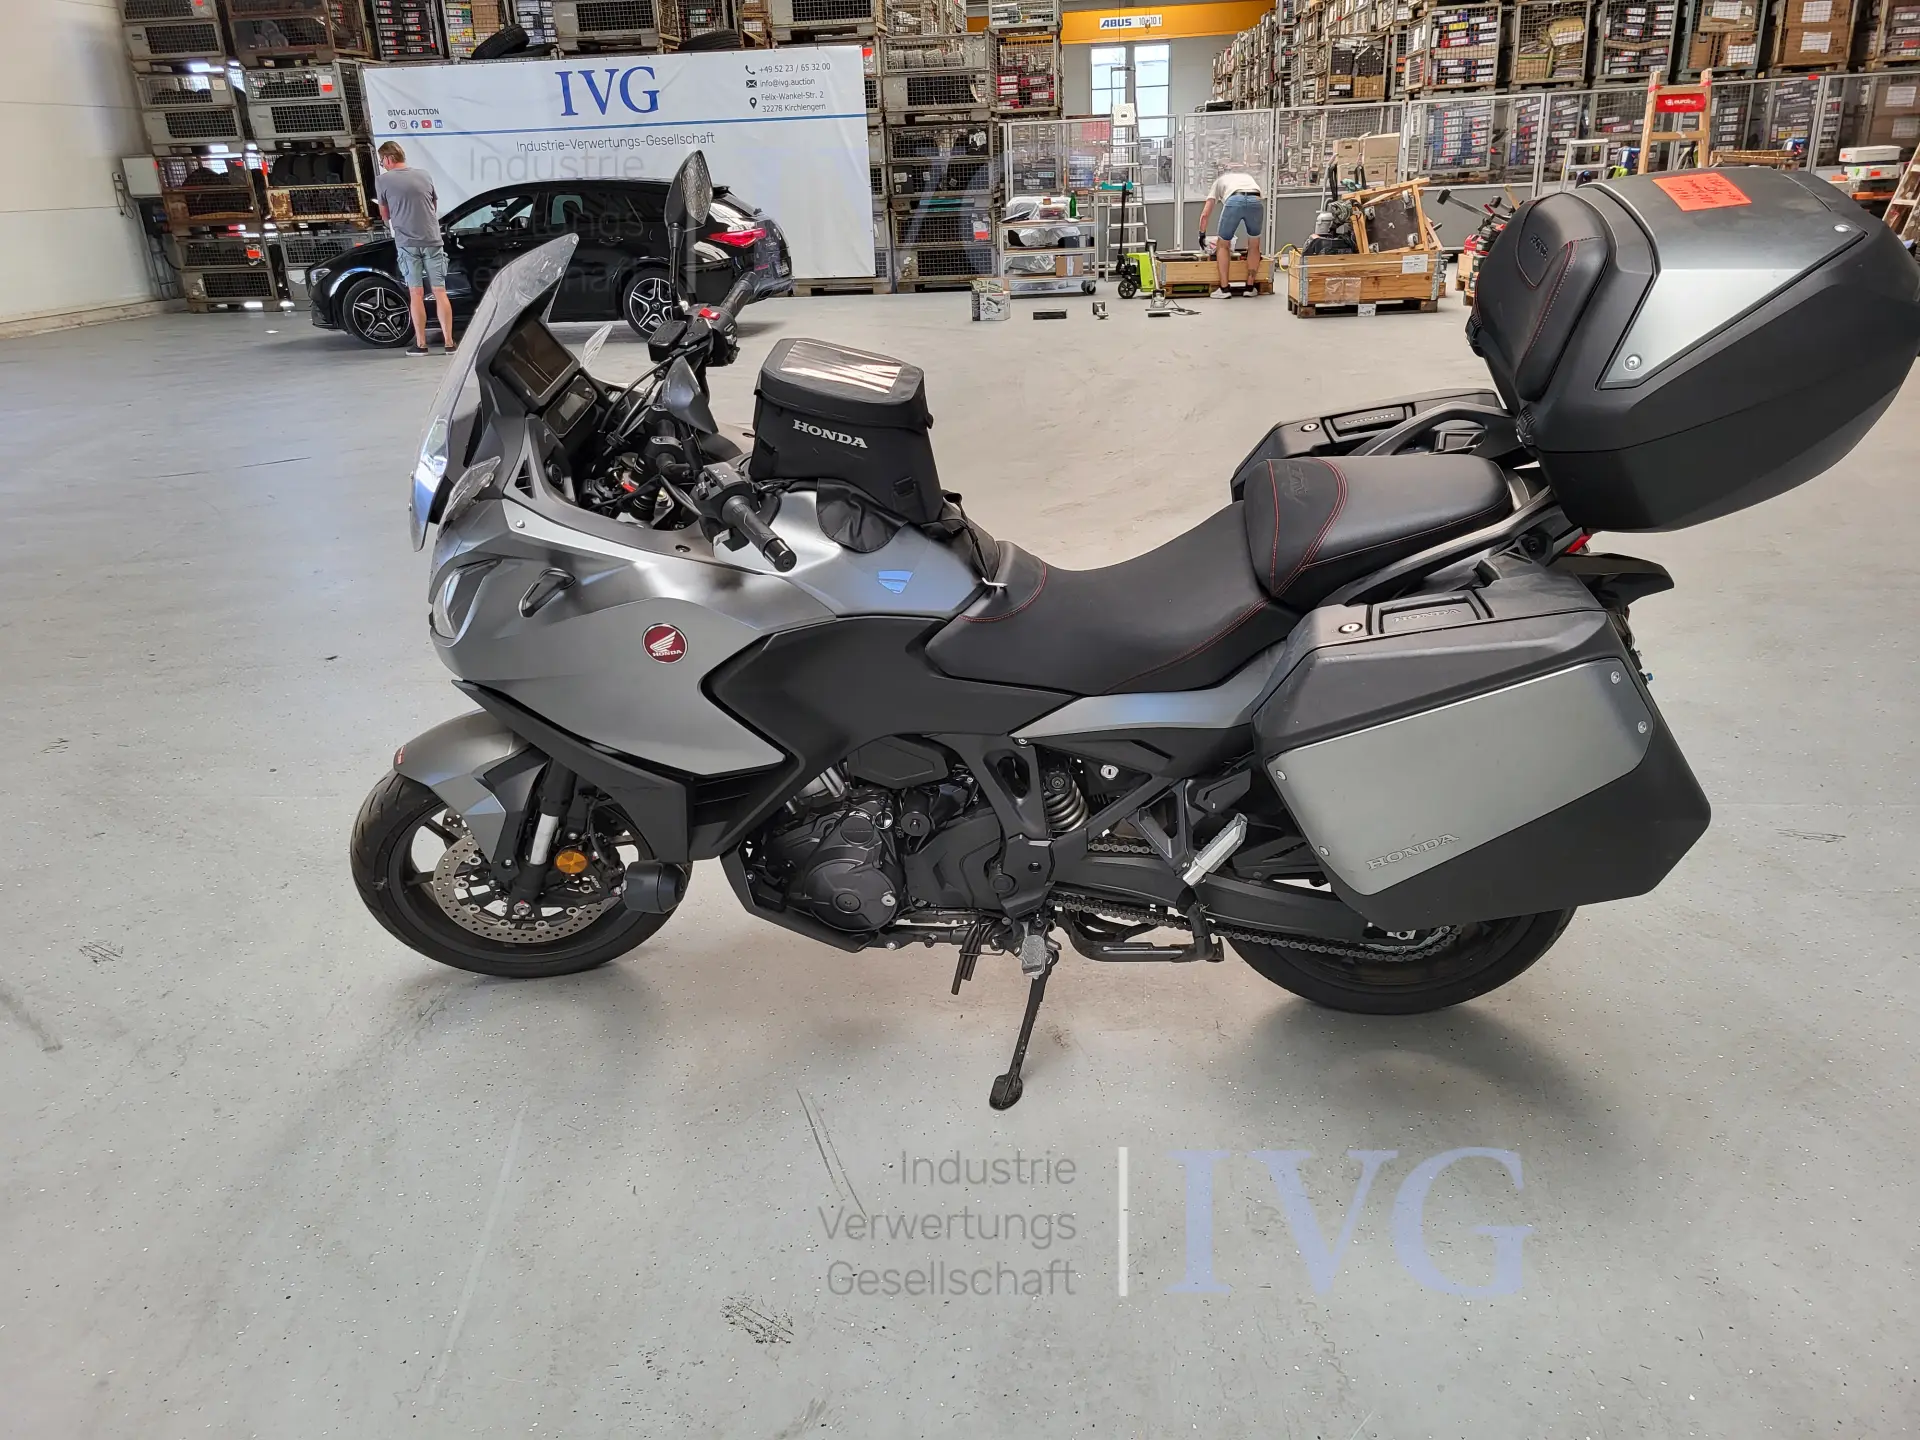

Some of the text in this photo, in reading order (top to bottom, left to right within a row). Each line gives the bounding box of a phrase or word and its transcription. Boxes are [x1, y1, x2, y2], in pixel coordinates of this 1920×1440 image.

[1101, 18, 1132, 28] ABUS
[759, 65, 773, 73] +49
[774, 65, 783, 73] 52
[785, 64, 794, 72] 23
[801, 63, 810, 72] 65
[811, 63, 821, 71] 32
[822, 62, 831, 71] 00
[760, 78, 816, 88] info@ivg.auction
[555, 66, 660, 116] IVG
[761, 91, 824, 101] Felix-Wankel-Str. 2
[387, 108, 440, 117] @IVG.AUCTION
[762, 103, 827, 113] 32278 Kirchlengern
[516, 131, 716, 153] Industrie-Verwertungs-Gesellschaft
[792, 418, 868, 449] HONDA
[1393, 608, 1461, 624] HONDA
[652, 649, 683, 657] HONDA
[1365, 833, 1460, 871] HONDA
